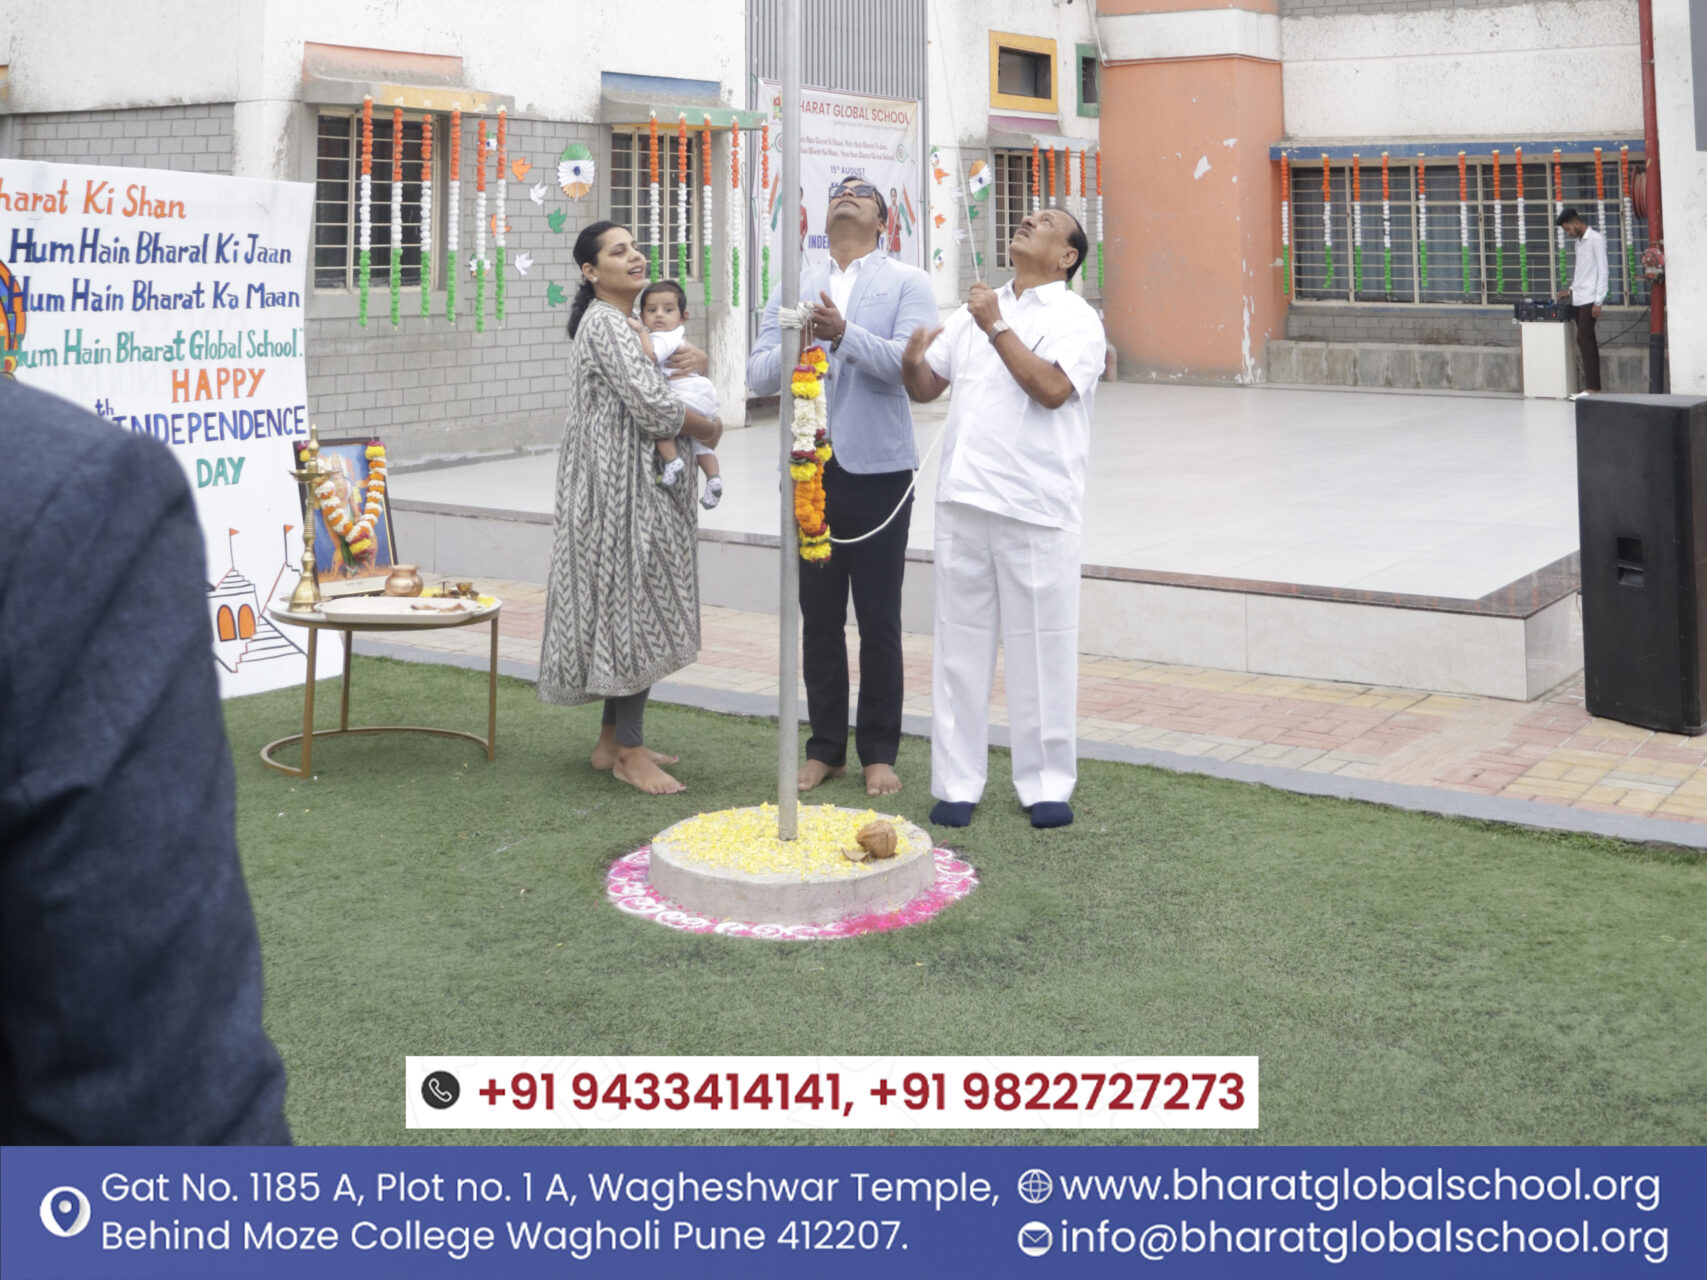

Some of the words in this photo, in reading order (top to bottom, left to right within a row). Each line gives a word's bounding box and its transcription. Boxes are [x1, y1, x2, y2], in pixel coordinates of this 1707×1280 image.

[800, 100, 831, 115] HARAT
[833, 103, 869, 120] GLOBAL
[871, 108, 910, 125] SCHOOL
[841, 166, 866, 176] AUGUST
[0, 178, 68, 214] harat
[83, 180, 115, 215] Ki
[122, 184, 187, 219] Shan
[8, 228, 75, 264] Hum
[79, 227, 130, 264] Hain
[214, 232, 241, 264] Ki
[244, 233, 292, 264] Jaan
[8, 276, 65, 312] Hum
[72, 278, 124, 312] Hain
[132, 280, 205, 312] Bharat
[212, 280, 239, 310] Ka
[245, 282, 300, 309] Maan
[63, 328, 111, 365] Hain
[116, 330, 185, 362] Bharat
[189, 330, 242, 360] Global
[171, 368, 266, 403] HAPPY
[196, 457, 246, 488] DAY
